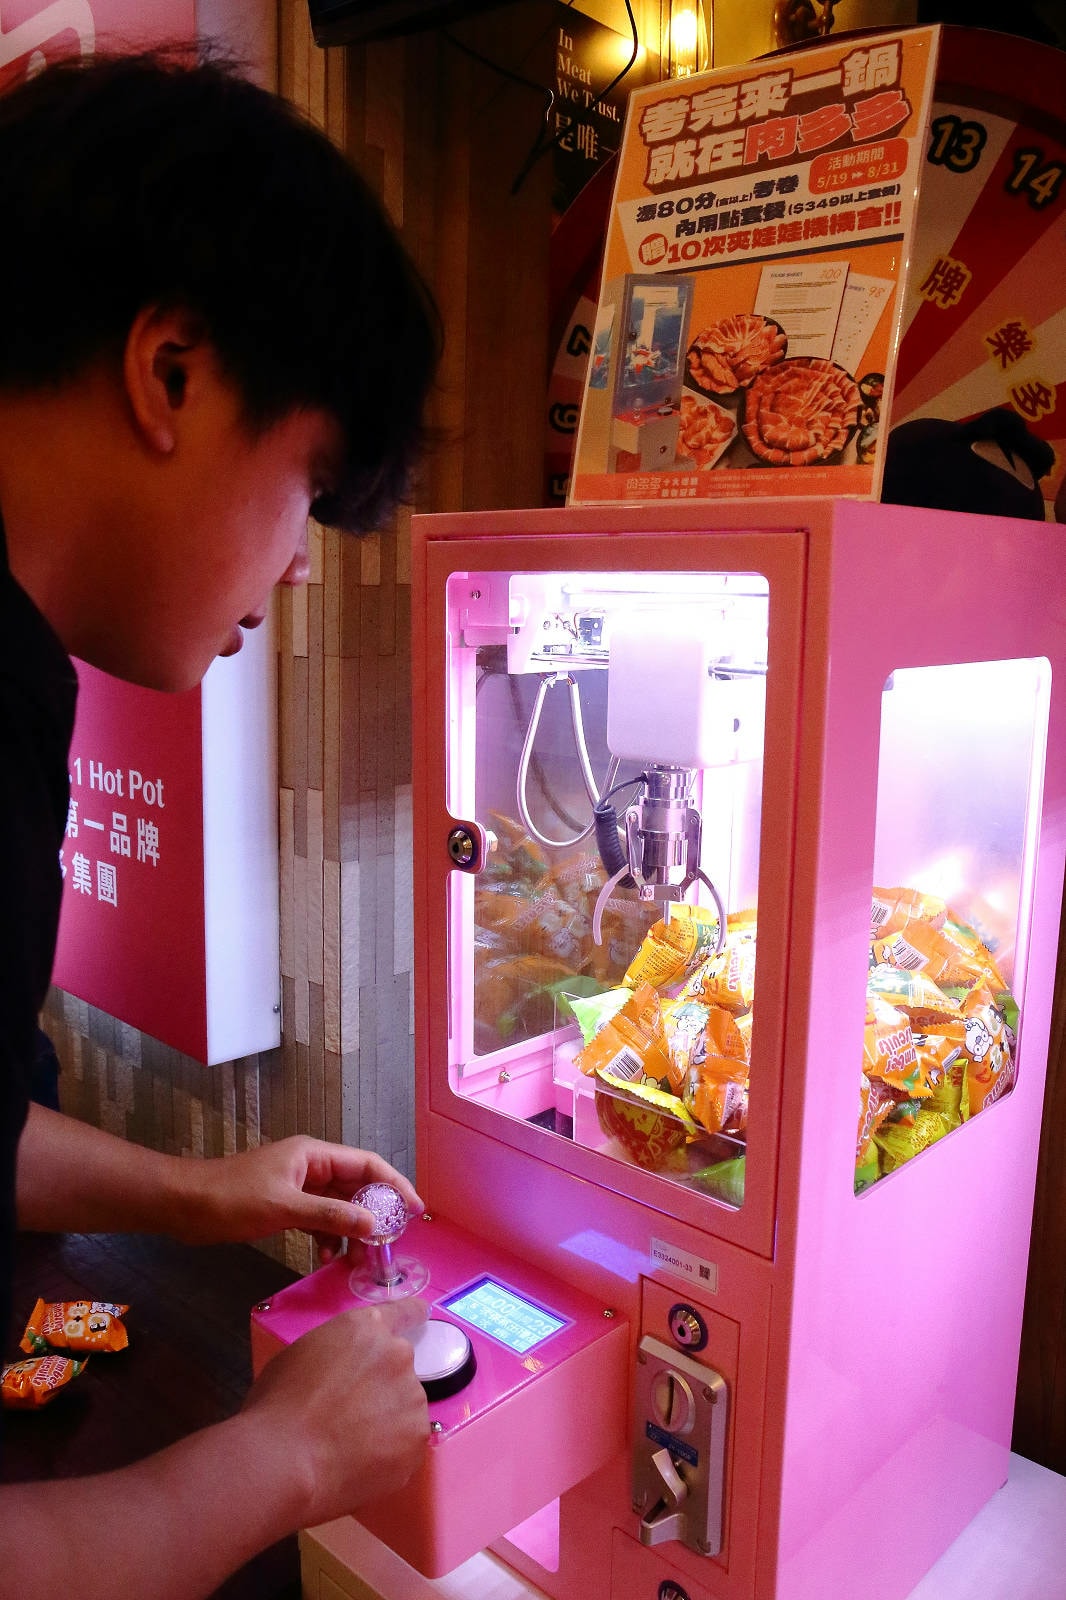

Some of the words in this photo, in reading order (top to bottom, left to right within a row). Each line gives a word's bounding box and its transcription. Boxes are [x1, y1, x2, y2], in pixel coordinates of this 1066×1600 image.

[559, 28, 573, 51] In
[557, 52, 592, 85] Meat
[557, 77, 579, 103] We
[641, 42, 900, 144] 考完來一鍋
[647, 90, 911, 185] 就在肉多多
[930, 117, 985, 171] 13
[816, 172, 848, 189] 5/19
[867, 162, 899, 179] 8/31
[828, 146, 885, 171] 活動期間
[1007, 149, 1064, 207] 14
[919, 258, 968, 303] 牌
[1011, 381, 1052, 417] 多
[89, 760, 124, 797] Hot
[129, 769, 166, 808] Pot
